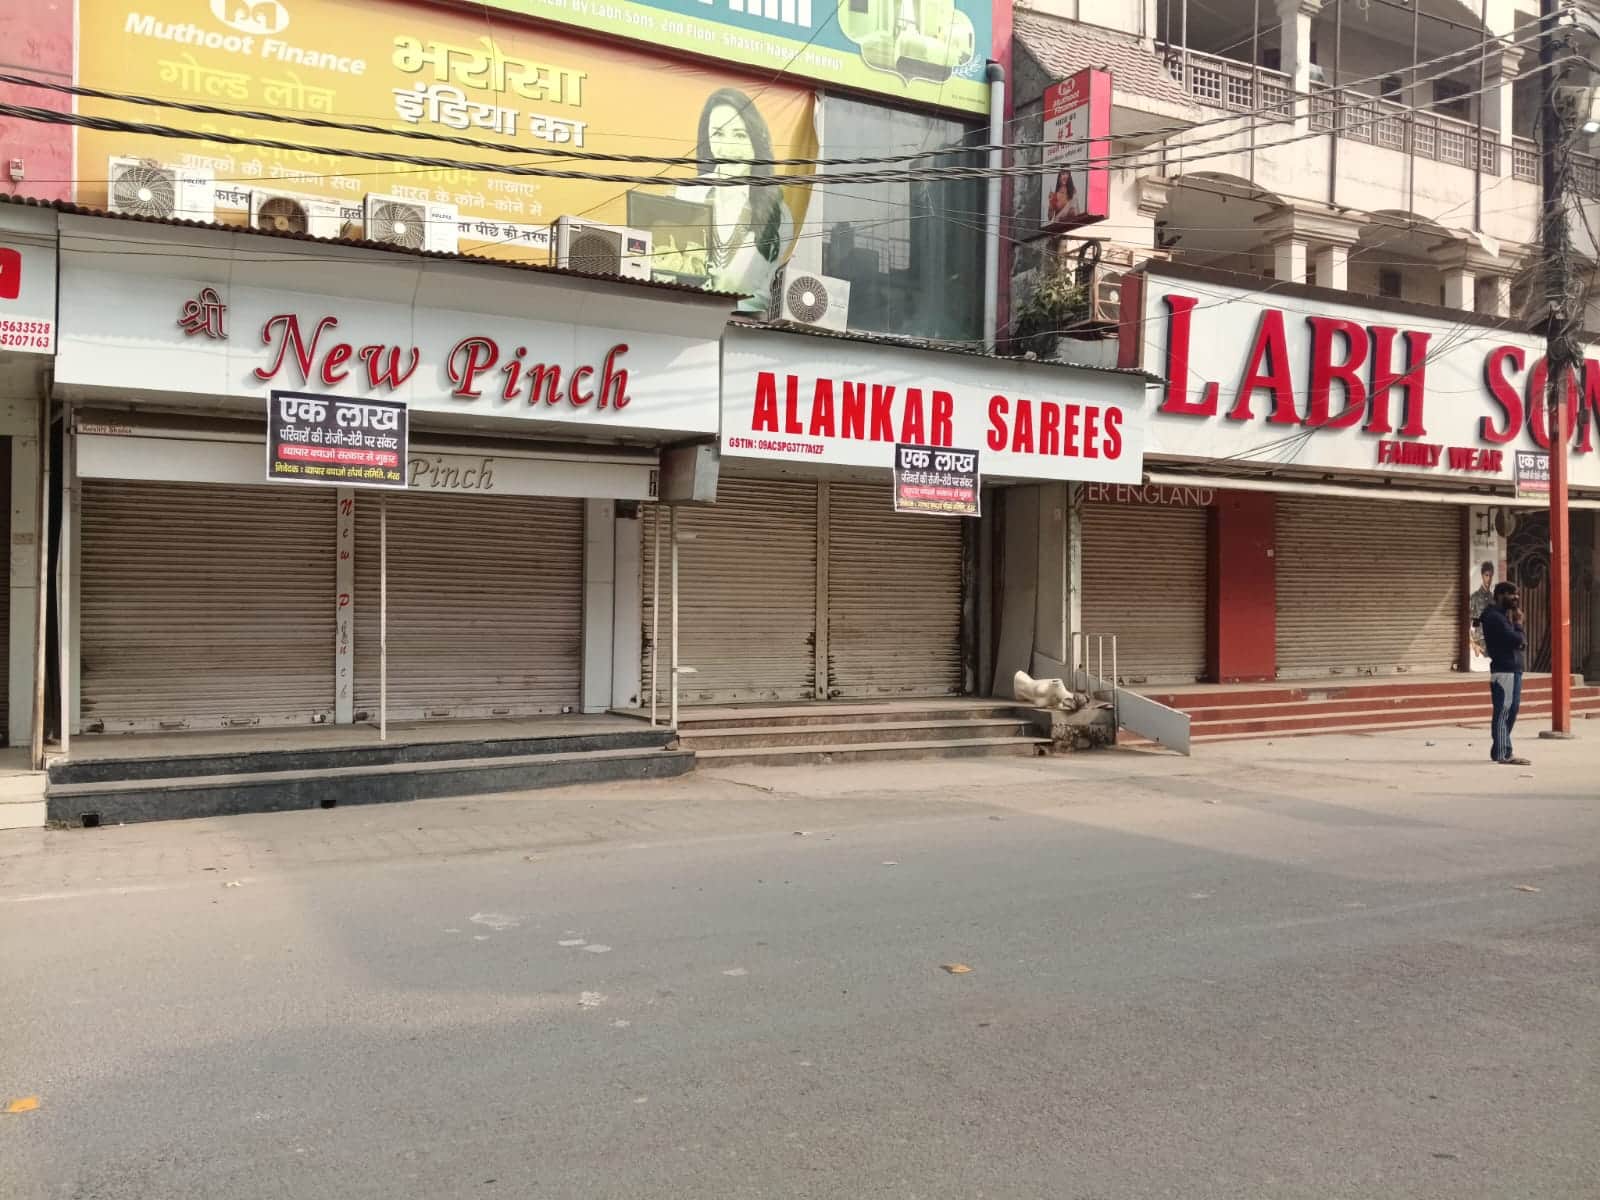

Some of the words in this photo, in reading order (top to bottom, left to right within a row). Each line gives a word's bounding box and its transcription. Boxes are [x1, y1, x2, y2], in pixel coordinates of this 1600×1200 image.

[124, 12, 254, 55] Muthoot
[261, 38, 367, 76] Finance
[157, 52, 252, 99] गोल्ड
[261, 71, 336, 113] लोन
[392, 34, 588, 107] भरोसा
[391, 81, 520, 136] इंडिया
[528, 112, 588, 148] का
[475, 220, 500, 238] पीछे
[503, 225, 521, 241] की
[177, 287, 229, 339] श्री
[252, 312, 420, 391] New
[446, 336, 632, 410] Pinch
[1161, 294, 1433, 437] LABH
[279, 396, 329, 423] एक
[335, 402, 401, 430] लाख
[280, 424, 311, 443] परिवारों
[311, 427, 323, 444] की
[364, 435, 375, 448] पर
[376, 432, 398, 450] संकट
[752, 371, 954, 447] ALANKAR
[987, 394, 1123, 460] SAREES
[407, 457, 494, 490] Pinch
[900, 448, 932, 469] एक
[934, 451, 976, 473] लाख
[1378, 439, 1443, 468] FAMILY
[1448, 446, 1503, 472] WEAR
[1116, 484, 1214, 506] ENGLAND
